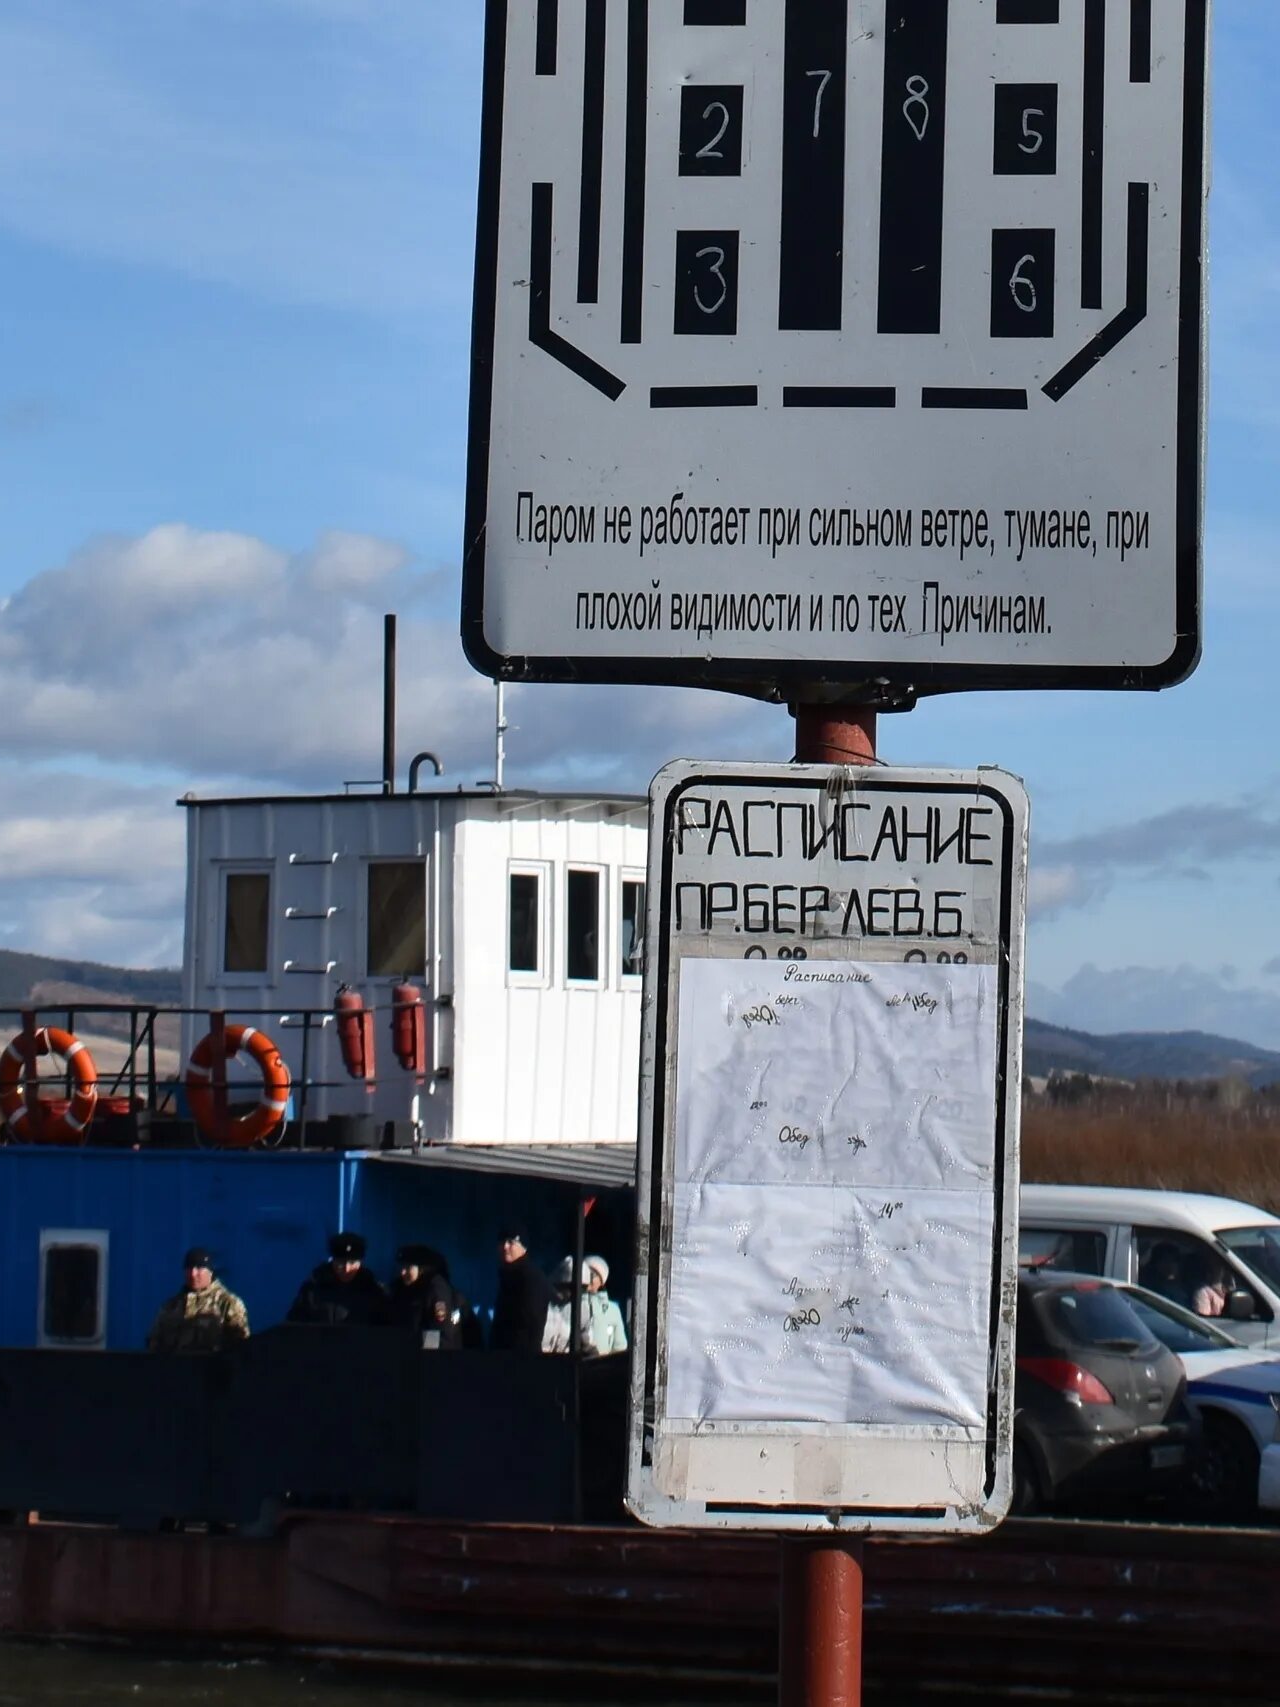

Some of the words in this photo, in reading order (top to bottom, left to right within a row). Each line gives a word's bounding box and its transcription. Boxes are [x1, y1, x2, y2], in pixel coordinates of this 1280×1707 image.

[695, 102, 730, 158] 2
[806, 70, 832, 138] 7
[902, 75, 930, 141] 8
[1018, 108, 1044, 153] 5
[694, 246, 726, 313] 3
[1009, 254, 1037, 312] 6
[516, 491, 595, 556] Паром
[603, 505, 632, 544] не
[639, 491, 751, 557] работает
[758, 507, 801, 559] при
[808, 507, 912, 547] сильном
[920, 508, 995, 561] ветре,
[1003, 509, 1097, 562] тумане,
[1106, 510, 1150, 563] при
[576, 578, 662, 630] плохой
[670, 592, 801, 640] видимости
[809, 593, 823, 632] и
[831, 594, 860, 633] по
[922, 581, 1052, 647] Причинам.
[677, 797, 994, 866] РАСПИСАНИЕ
[783, 963, 873, 983] Расписание
[778, 1125, 810, 1149] Обед
